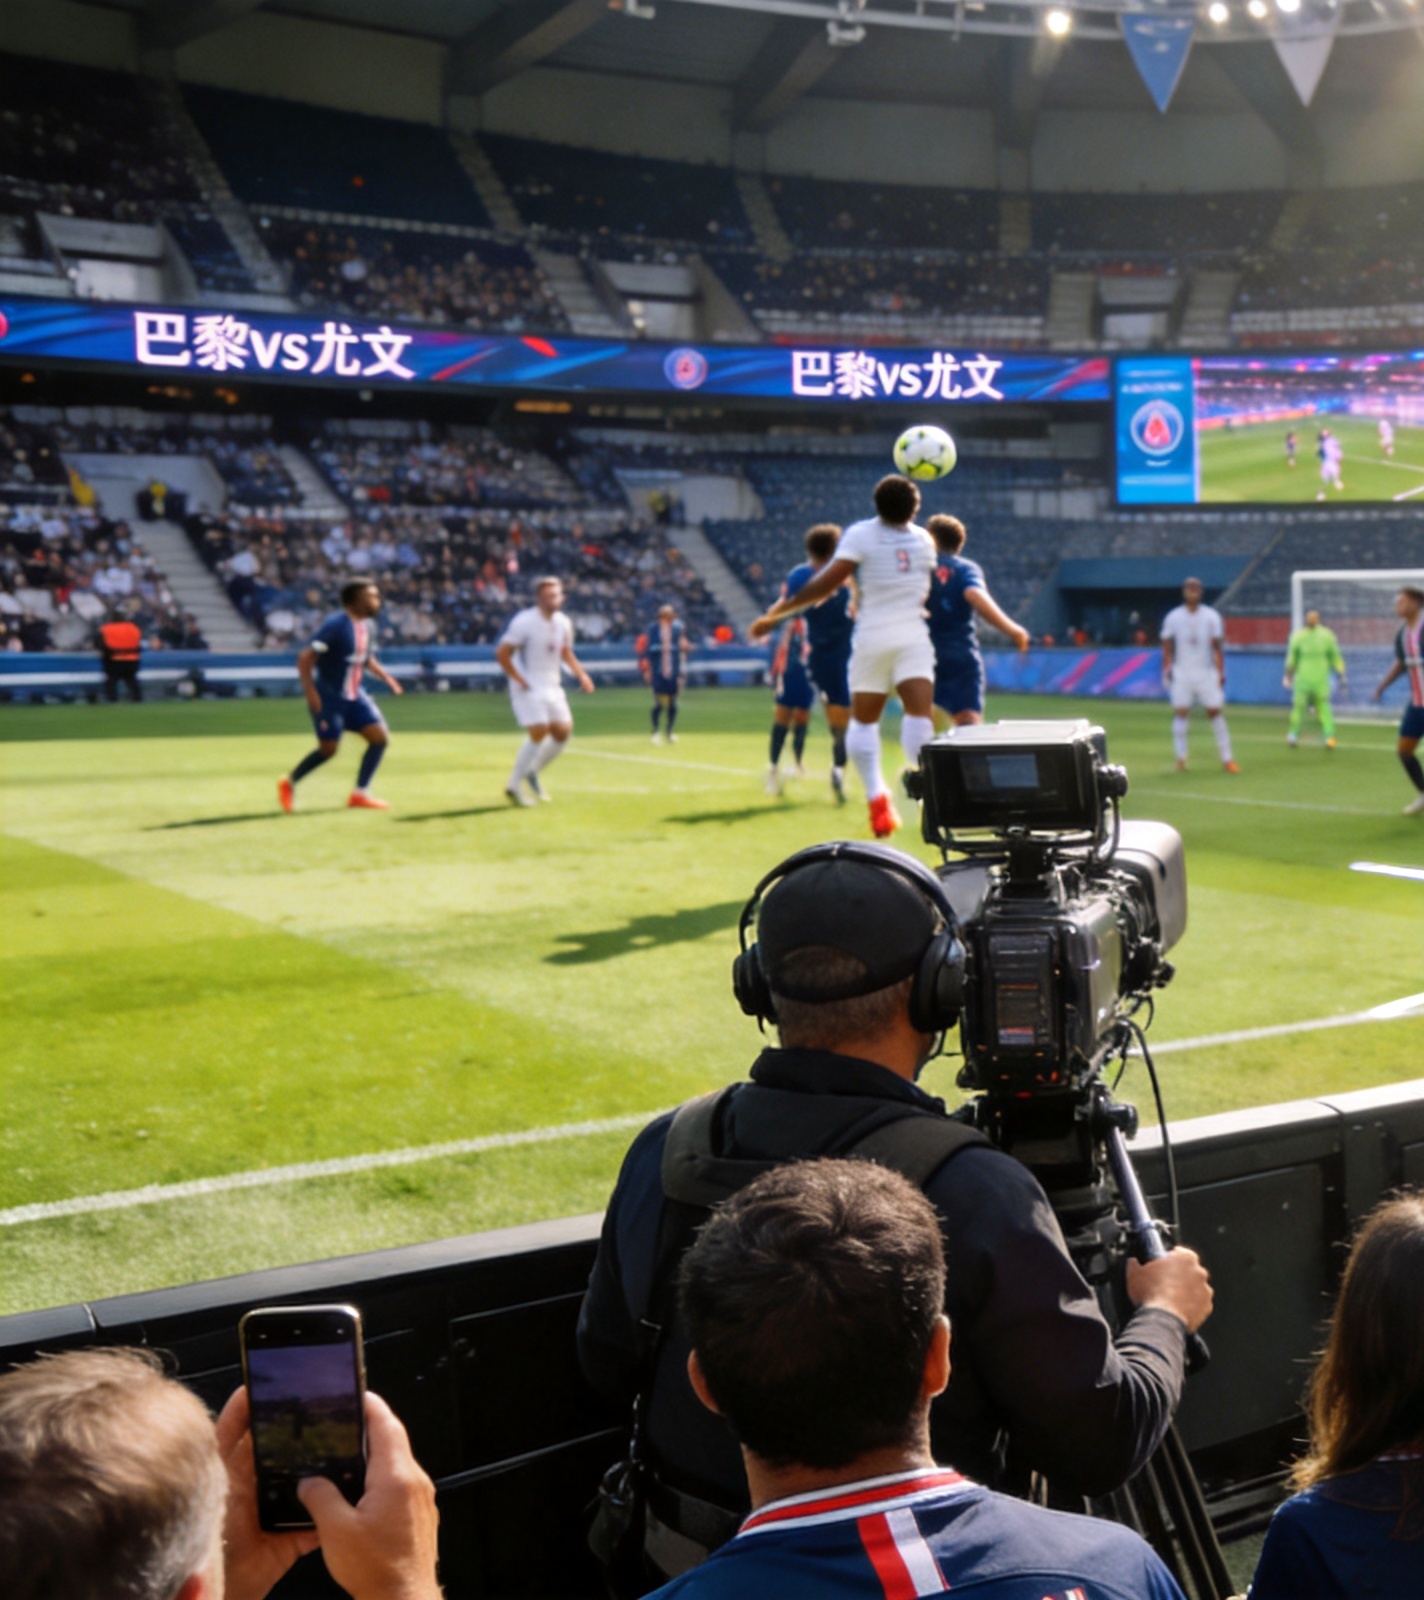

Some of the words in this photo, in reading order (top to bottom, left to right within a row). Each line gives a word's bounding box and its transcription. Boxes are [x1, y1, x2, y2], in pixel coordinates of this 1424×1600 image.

[134, 311, 416, 379] 巴黎vs尤文
[792, 351, 1004, 400] 巴黎vs尤文
